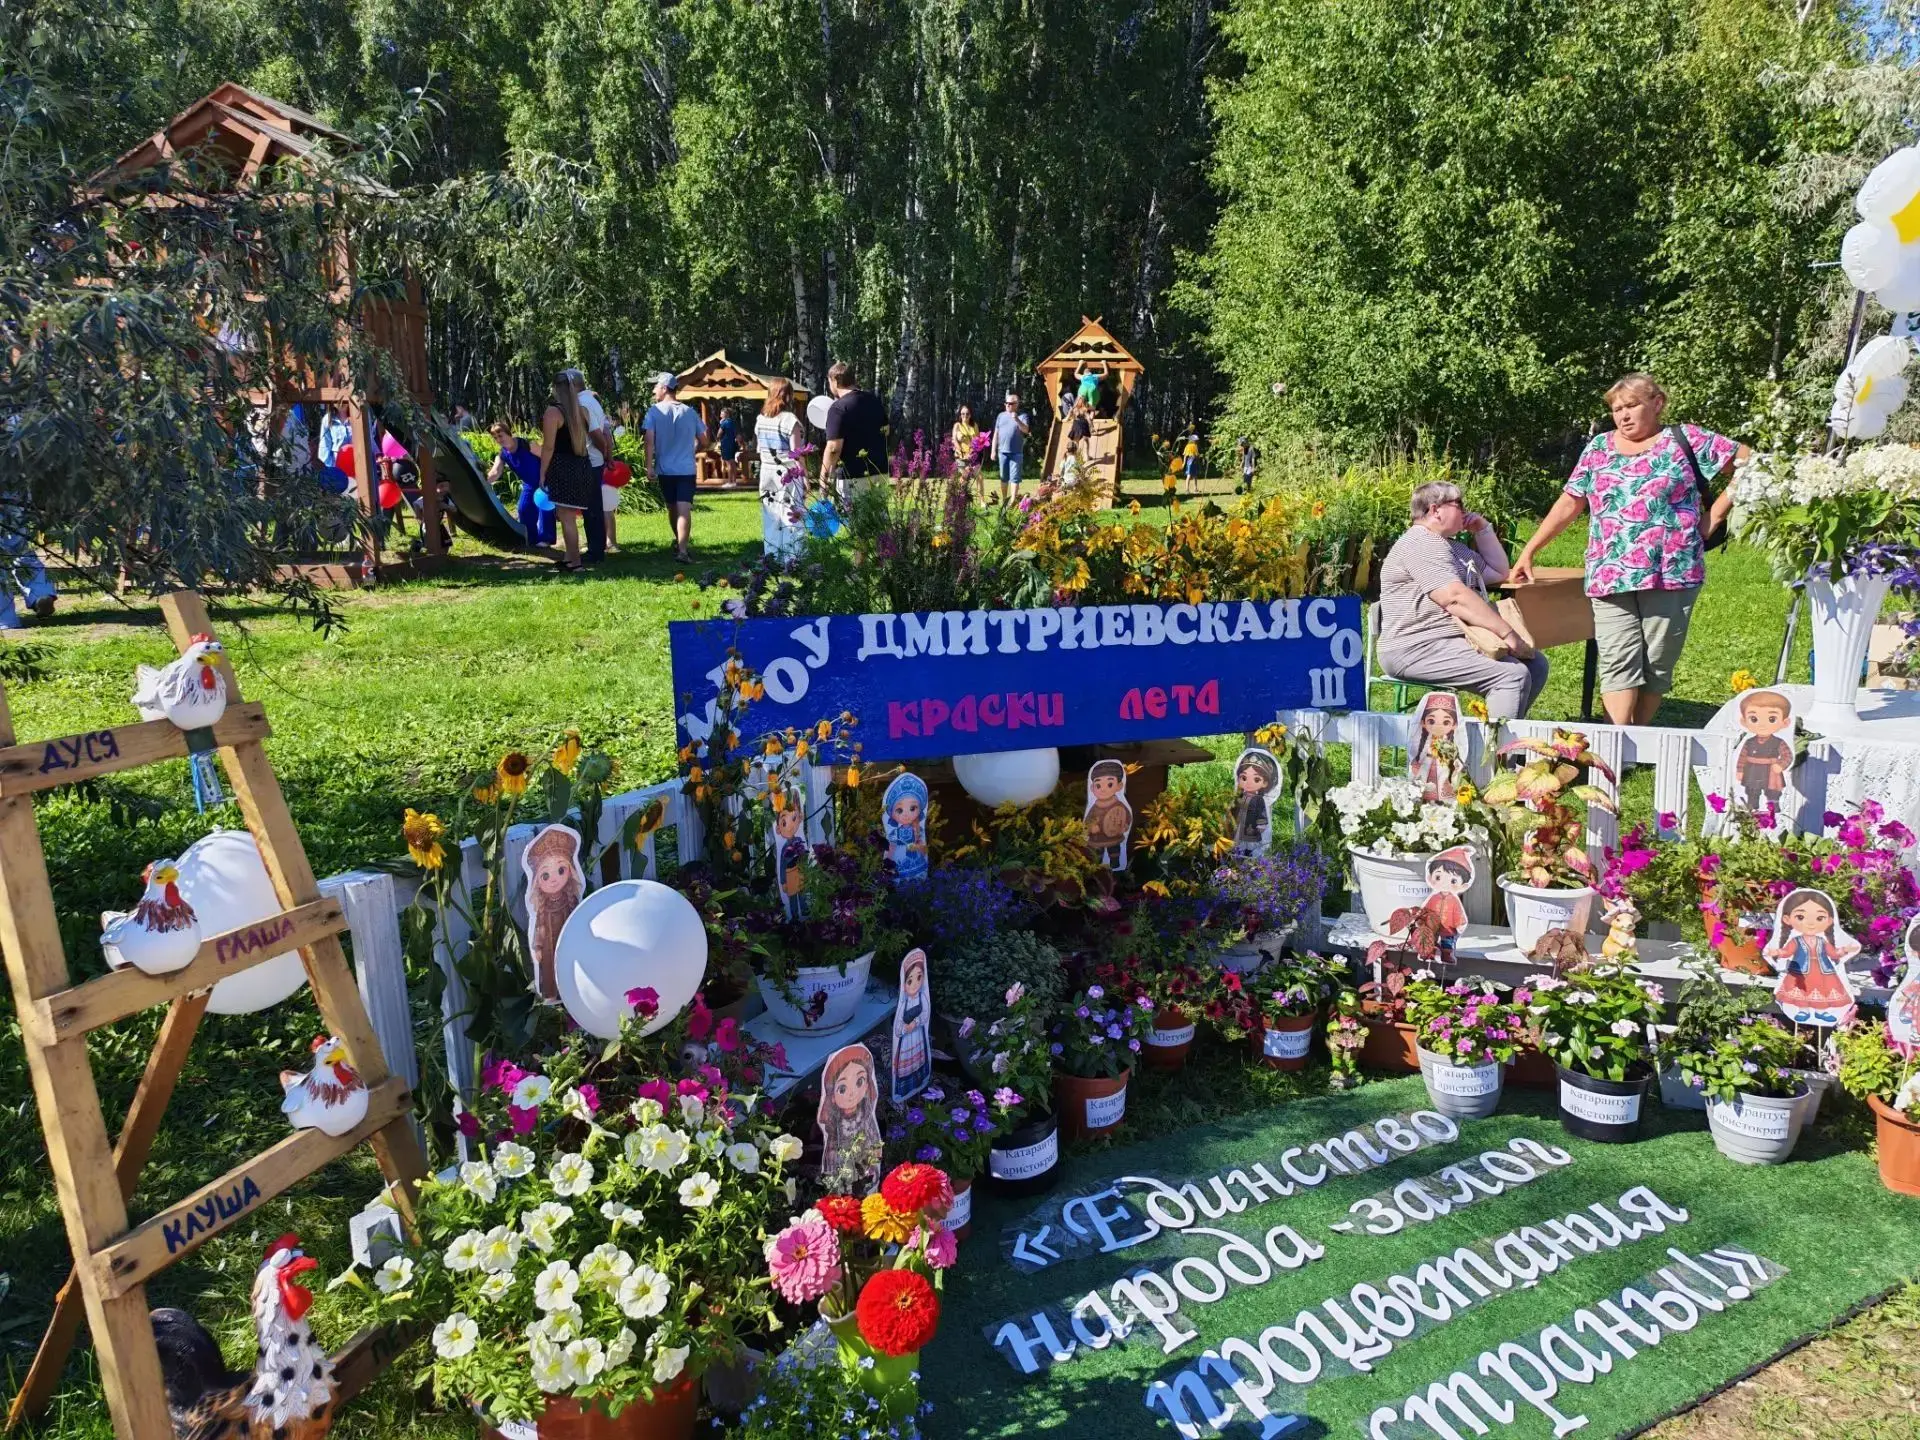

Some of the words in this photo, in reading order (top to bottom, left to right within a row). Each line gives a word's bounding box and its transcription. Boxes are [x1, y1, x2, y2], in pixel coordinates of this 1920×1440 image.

[857, 598, 1302, 662] ДМИТРИЕВСКАЯ
[1119, 679, 1220, 720] лета
[38, 729, 119, 774] ДУСЯ
[215, 917, 297, 965] ГЛАША
[1568, 1103, 1631, 1122] аристократ
[1569, 1087, 1633, 1108] Катарантус
[162, 1176, 261, 1254] КЛУША
[993, 1224, 1325, 1375] народа
[1145, 1184, 1689, 1440] процветания
